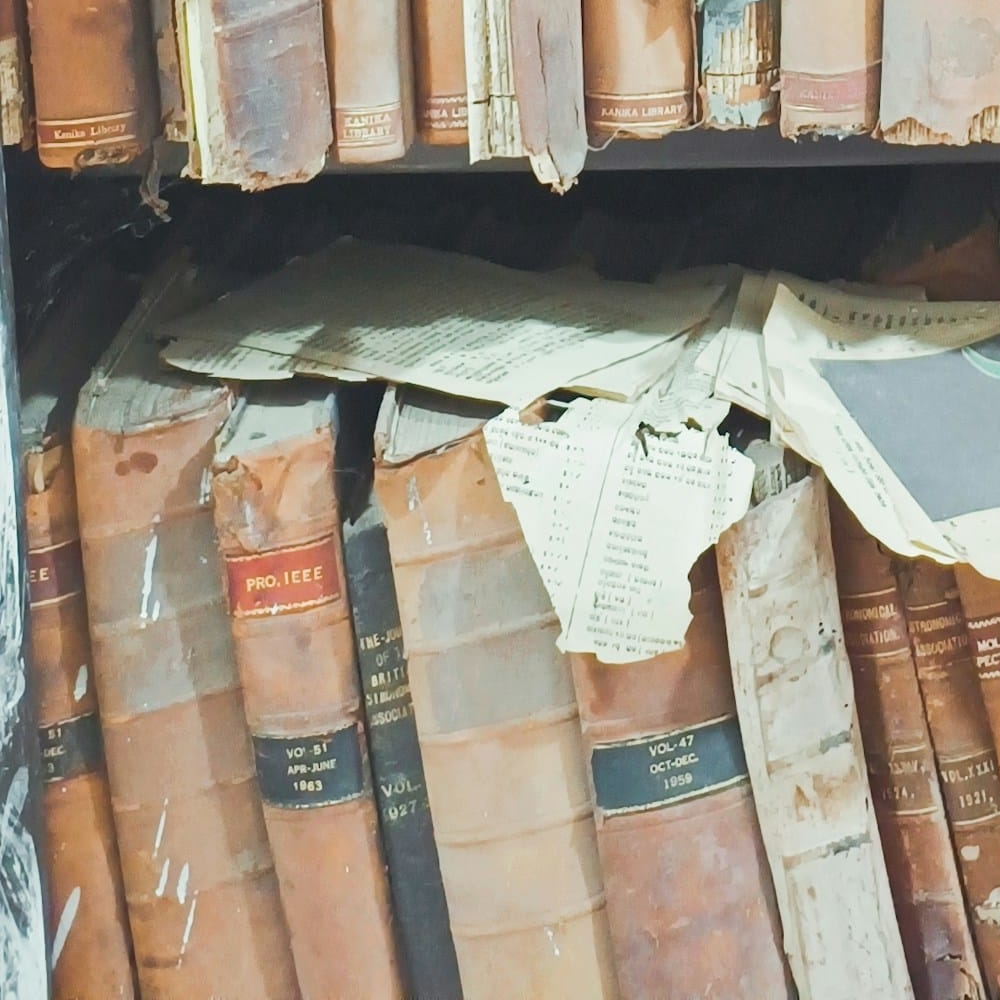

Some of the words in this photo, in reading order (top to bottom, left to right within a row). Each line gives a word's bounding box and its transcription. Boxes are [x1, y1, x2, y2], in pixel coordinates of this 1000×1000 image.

[600, 106, 640, 119] KANIKA
[641, 103, 684, 118] LIBRARY
[245, 575, 281, 593] PRO.
[283, 565, 324, 586] IEEE
[292, 780, 324, 793] 1963
[663, 772, 694, 790] 1959
